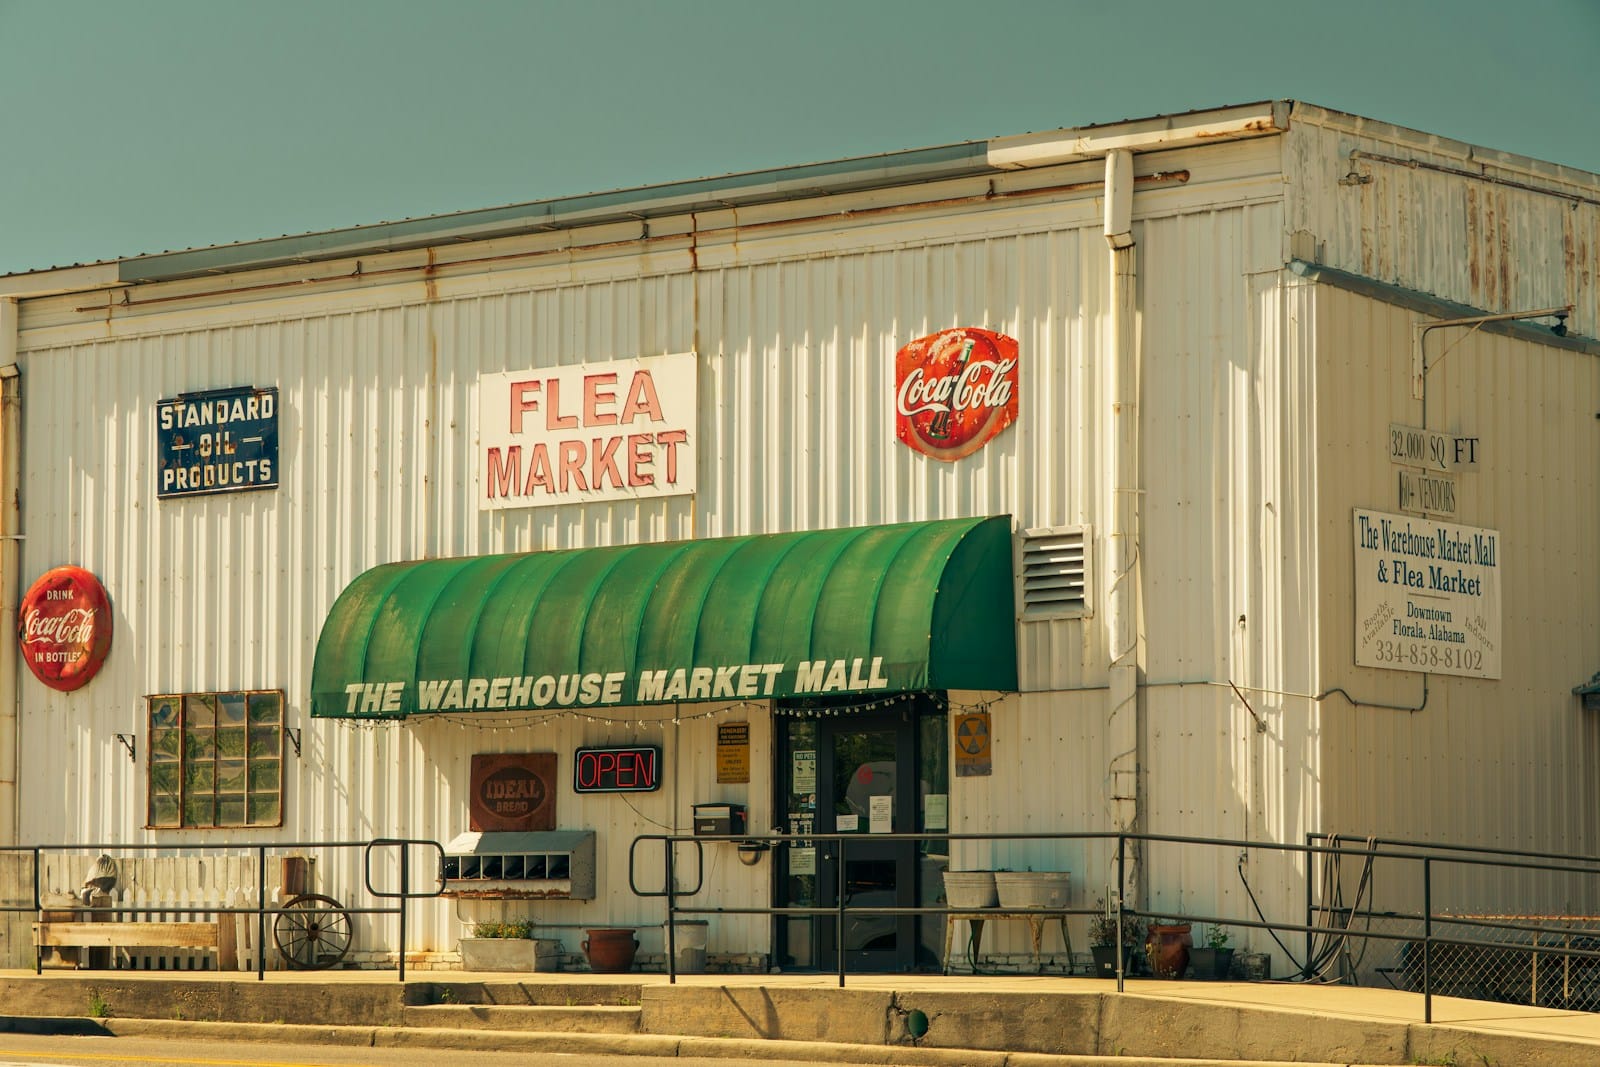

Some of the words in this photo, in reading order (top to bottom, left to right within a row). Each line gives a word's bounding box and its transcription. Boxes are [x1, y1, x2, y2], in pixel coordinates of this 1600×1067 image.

[510, 369, 664, 434] FLEA
[897, 358, 1017, 416] Coca-Cola
[160, 394, 274, 430] STANDARD
[199, 432, 236, 457] OIL
[1391, 429, 1425, 461] 32,000
[1430, 435, 1447, 469] SQ
[1452, 438, 1480, 463] FT
[163, 459, 271, 491] PRODUCTS
[487, 430, 687, 499] MARKET
[1418, 478, 1456, 513] VENDORS
[1359, 515, 1379, 551] The
[1381, 519, 1435, 560] Warehouse
[1437, 528, 1472, 566] Market
[1474, 533, 1496, 567] Mall
[46, 589, 74, 600] DRINK
[1377, 559, 1389, 584] &
[1393, 560, 1425, 589] Flea
[1428, 565, 1482, 597] Market
[25, 607, 98, 645] Coca-Cola
[1361, 606, 1395, 649] Available
[1363, 600, 1389, 632] Booths
[1407, 601, 1452, 623] Downtown
[1474, 615, 1488, 632] All
[1393, 619, 1427, 640] Florala,
[1428, 624, 1466, 644] Alabama
[1464, 616, 1495, 653] Indoors
[35, 652, 44, 663] IN
[1375, 639, 1483, 671] 334-858-8102
[345, 681, 406, 713] THE
[418, 671, 626, 710] WAREHOUSE
[636, 663, 785, 701] MARKET
[793, 656, 889, 694] MALL
[578, 752, 654, 788] OPEN
[486, 779, 540, 800] IDEAL
[496, 801, 529, 813] BREAD
